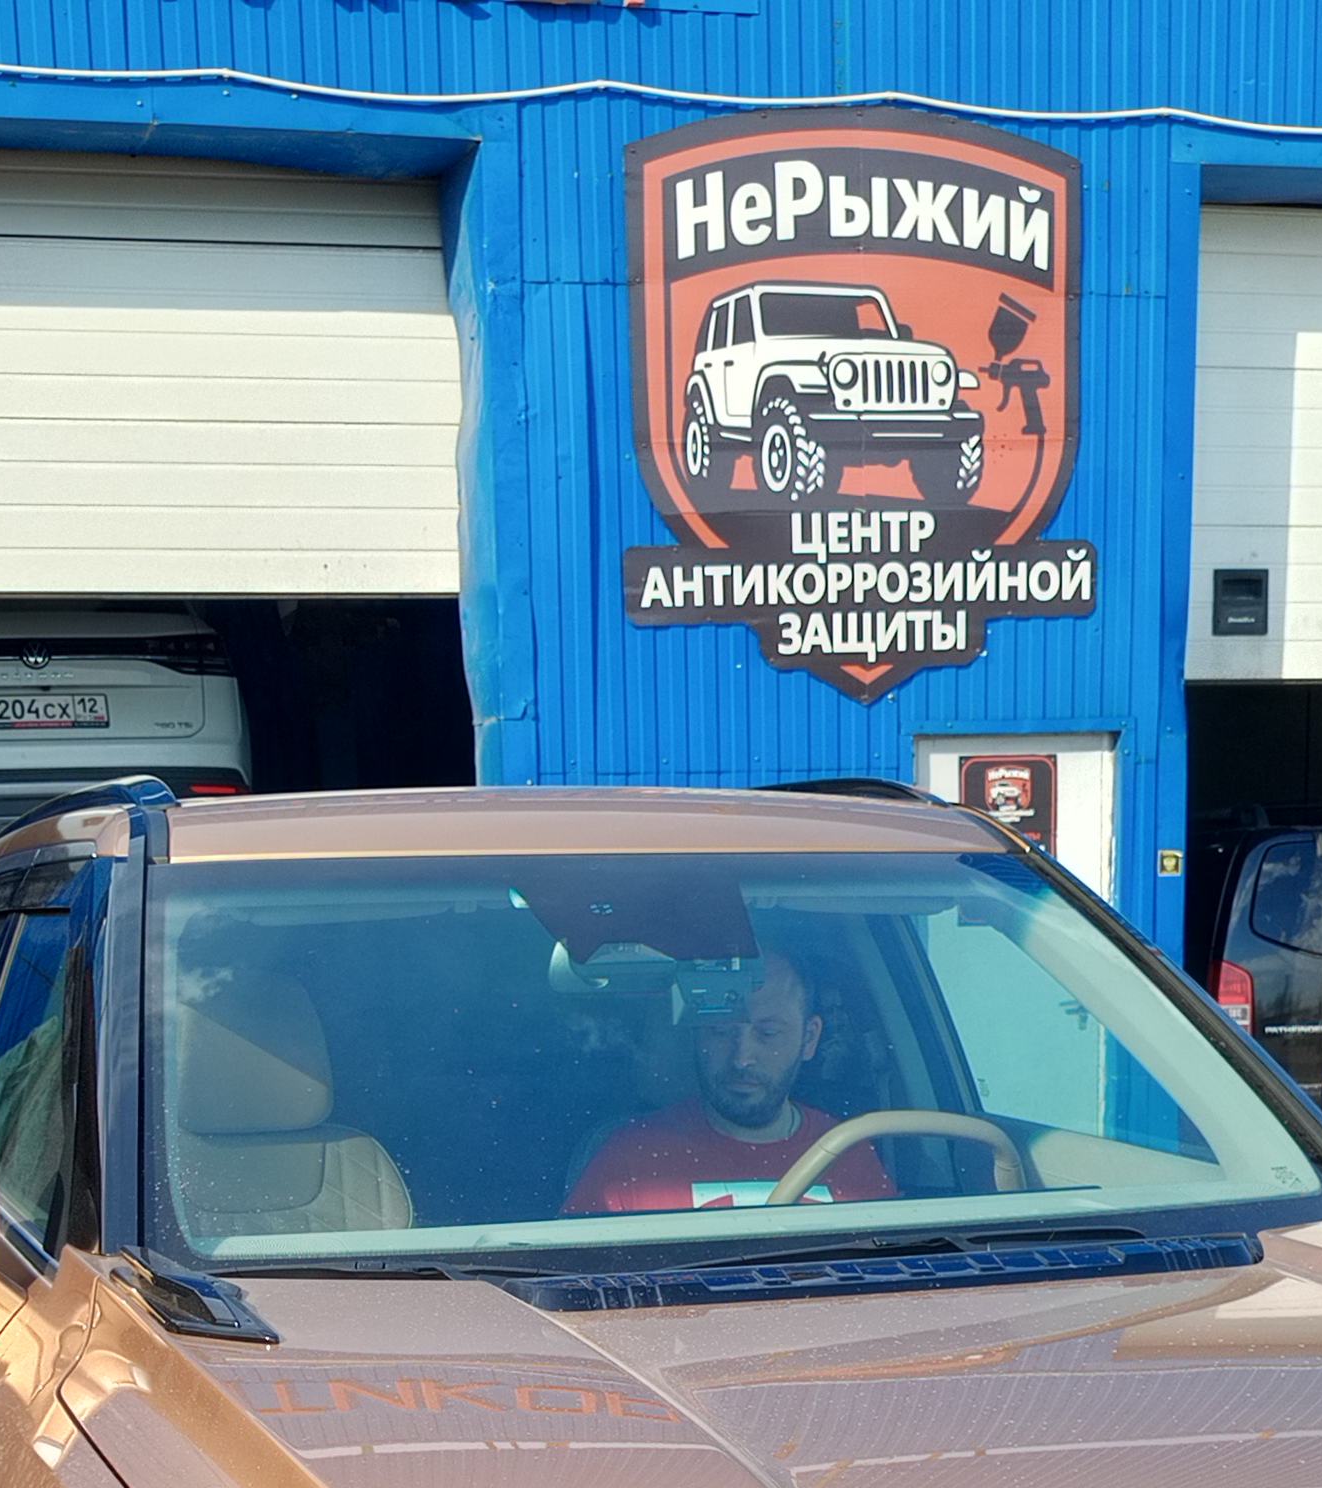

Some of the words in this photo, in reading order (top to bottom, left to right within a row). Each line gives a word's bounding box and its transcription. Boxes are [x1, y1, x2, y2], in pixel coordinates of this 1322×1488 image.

[675, 160, 1050, 271] НеРыжий
[791, 511, 935, 563] ЦЕНТР
[640, 549, 1091, 608] АНТИКОРРОЗИЙНОЙ
[777, 609, 966, 662] ЗАЩИТЫ
[76, 697, 99, 714] 12
